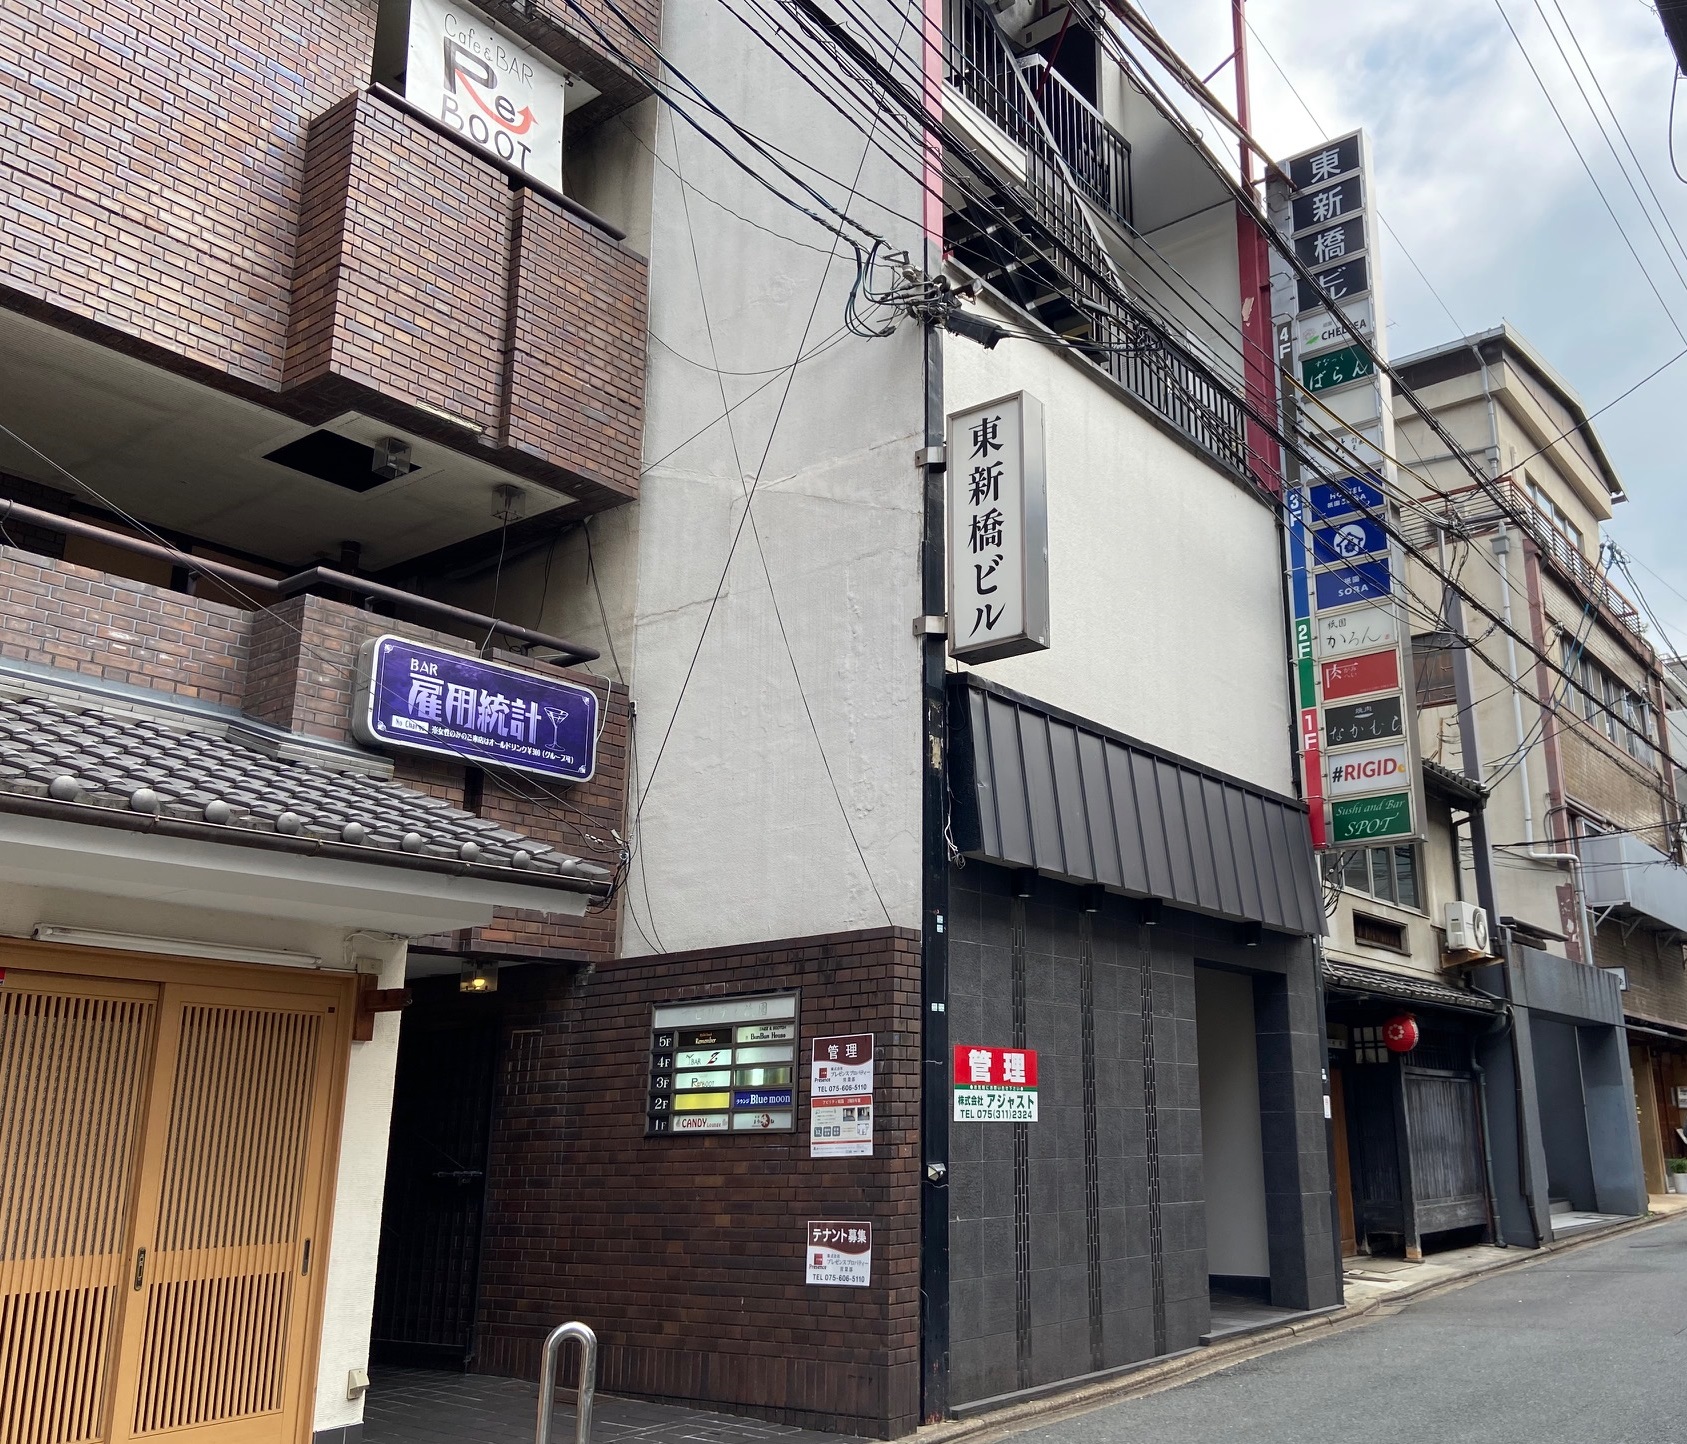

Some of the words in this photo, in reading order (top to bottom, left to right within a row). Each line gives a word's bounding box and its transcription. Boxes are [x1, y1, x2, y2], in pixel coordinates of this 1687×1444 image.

[441, 93, 532, 172] BOOT
[1279, 326, 1291, 359] 4F
[1309, 360, 1368, 390] ばらん
[1289, 494, 1302, 527] 3F
[967, 414, 1006, 638] 東新橋ビル
[1338, 584, 1369, 597] SORA
[1297, 624, 1310, 658] 2F
[410, 658, 438, 676] BAR
[408, 672, 542, 745] 雇用統計
[1304, 714, 1317, 749] 1F
[1332, 757, 1398, 783] #RIGID
[1336, 801, 1362, 816] Sushi
[1363, 798, 1383, 813] and
[1385, 798, 1405, 810] Bar
[1344, 812, 1400, 837] SPOT
[659, 1035, 671, 1047] 5F
[827, 1043, 858, 1060] 管理
[657, 1057, 671, 1068] 4F
[968, 1049, 1026, 1083] 管理
[656, 1077, 669, 1088] 3F
[828, 1084, 867, 1092] 075-606-5110
[654, 1098, 668, 1110] 2F
[750, 1094, 768, 1105] Blue
[769, 1094, 791, 1104] moon
[958, 1095, 984, 1106] 株式会社
[987, 1093, 1034, 1109] アジャスト
[960, 1110, 975, 1118] TEL
[976, 1110, 1033, 1119] 075(311)2324
[655, 1119, 667, 1131] 1F
[681, 1118, 708, 1129] CANDY
[812, 1228, 867, 1243] テナント募集
[824, 1274, 865, 1283] 075-606-5110
